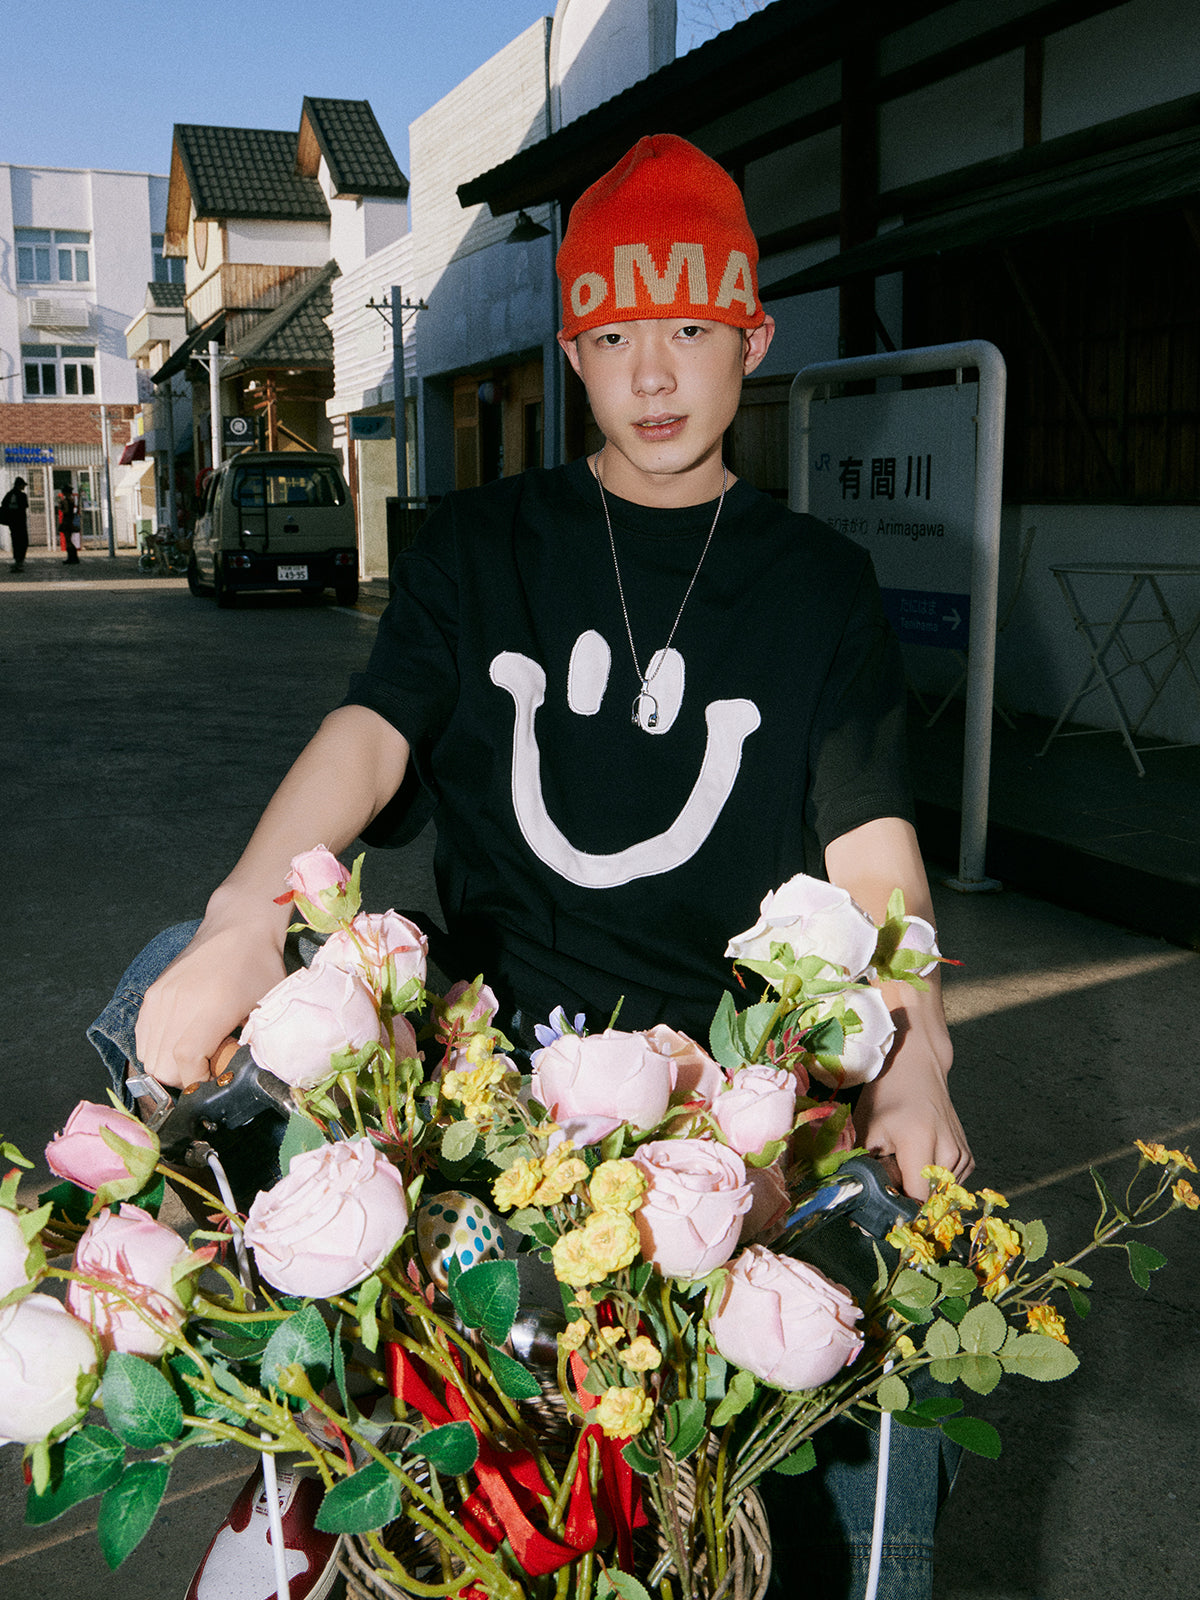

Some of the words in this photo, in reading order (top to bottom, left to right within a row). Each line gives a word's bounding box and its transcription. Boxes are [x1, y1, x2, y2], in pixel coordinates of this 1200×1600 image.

[814, 452, 831, 471] JR
[838, 454, 932, 501] 有間川
[876, 518, 945, 541] Arimagawa
